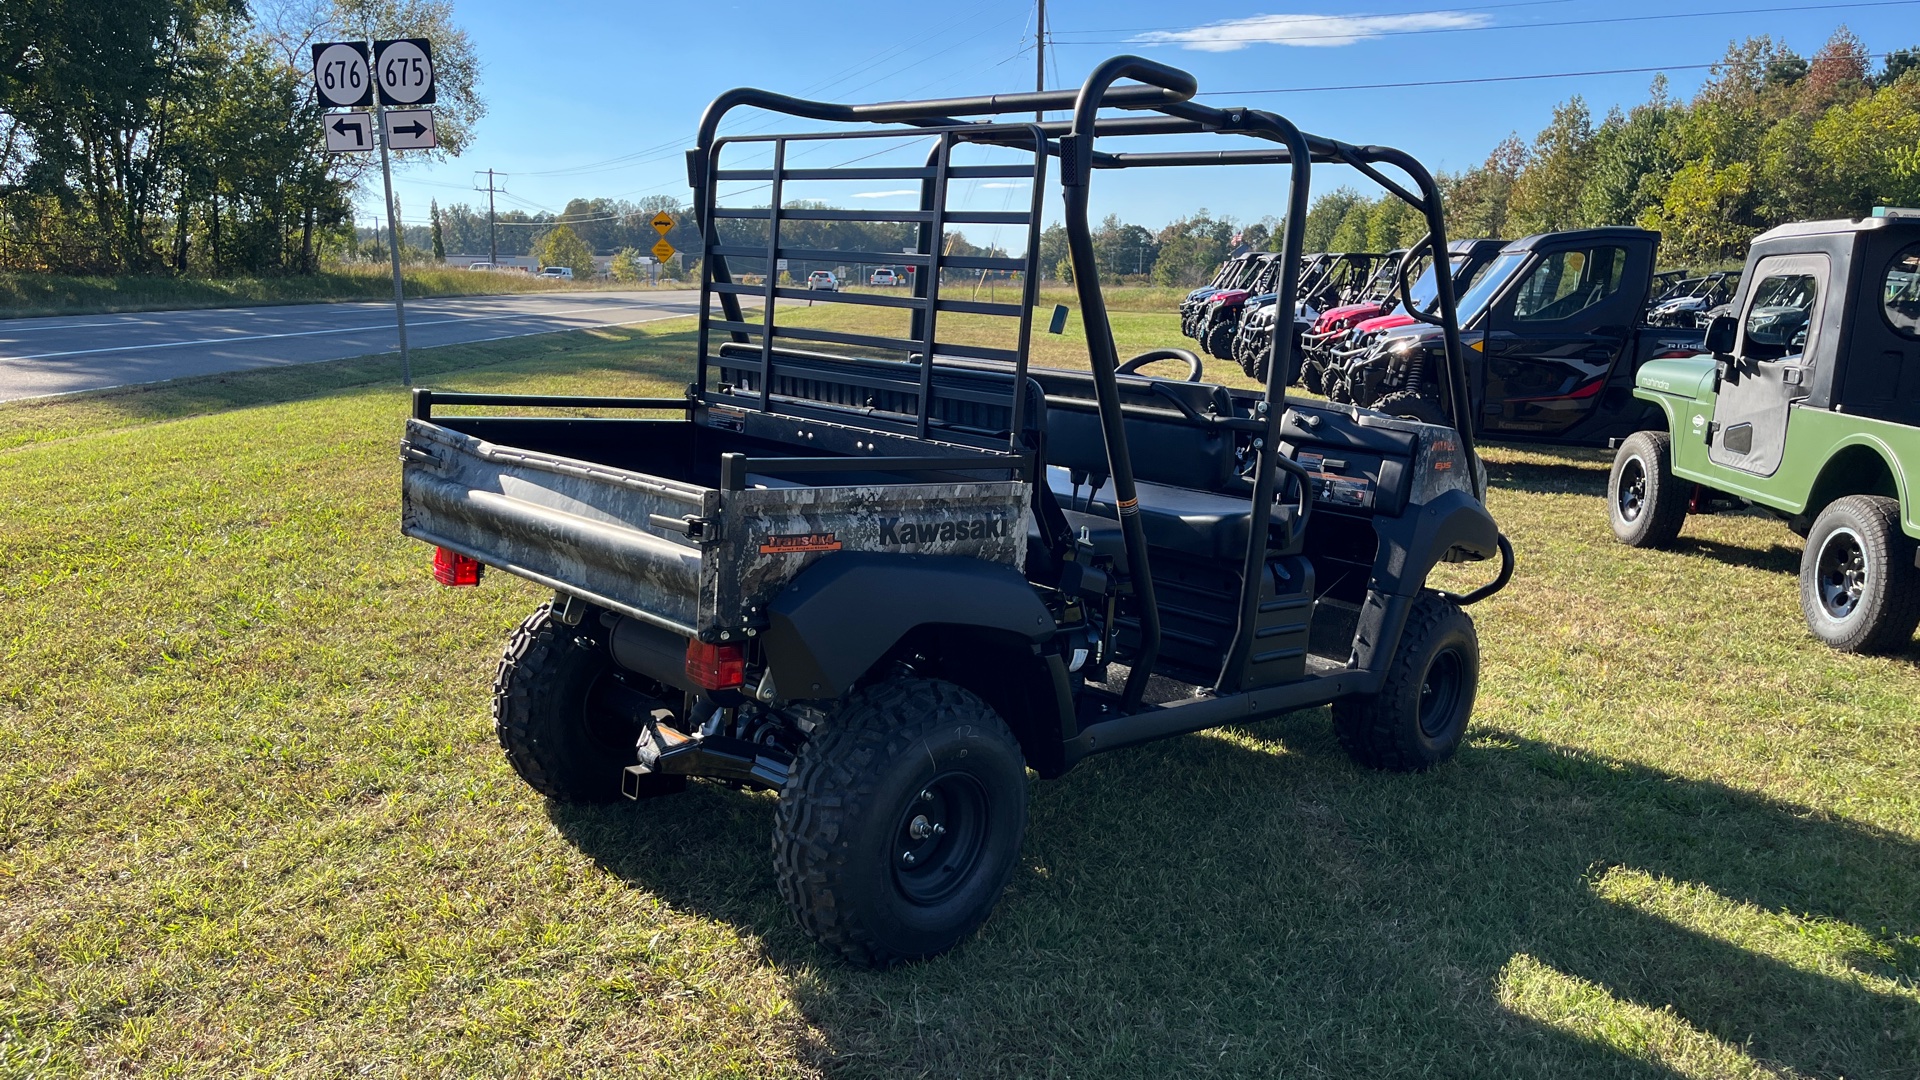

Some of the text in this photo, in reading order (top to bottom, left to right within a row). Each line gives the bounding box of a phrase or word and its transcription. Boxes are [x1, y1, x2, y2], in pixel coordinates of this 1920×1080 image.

[325, 60, 360, 89] 676
[386, 58, 424, 87] 675
[1641, 377, 1670, 390] mahindra
[1498, 421, 1543, 430] Kawasaki
[879, 511, 1007, 546] Kawasaki
[768, 533, 834, 547] Trans4x4
[954, 724, 979, 740] 12
